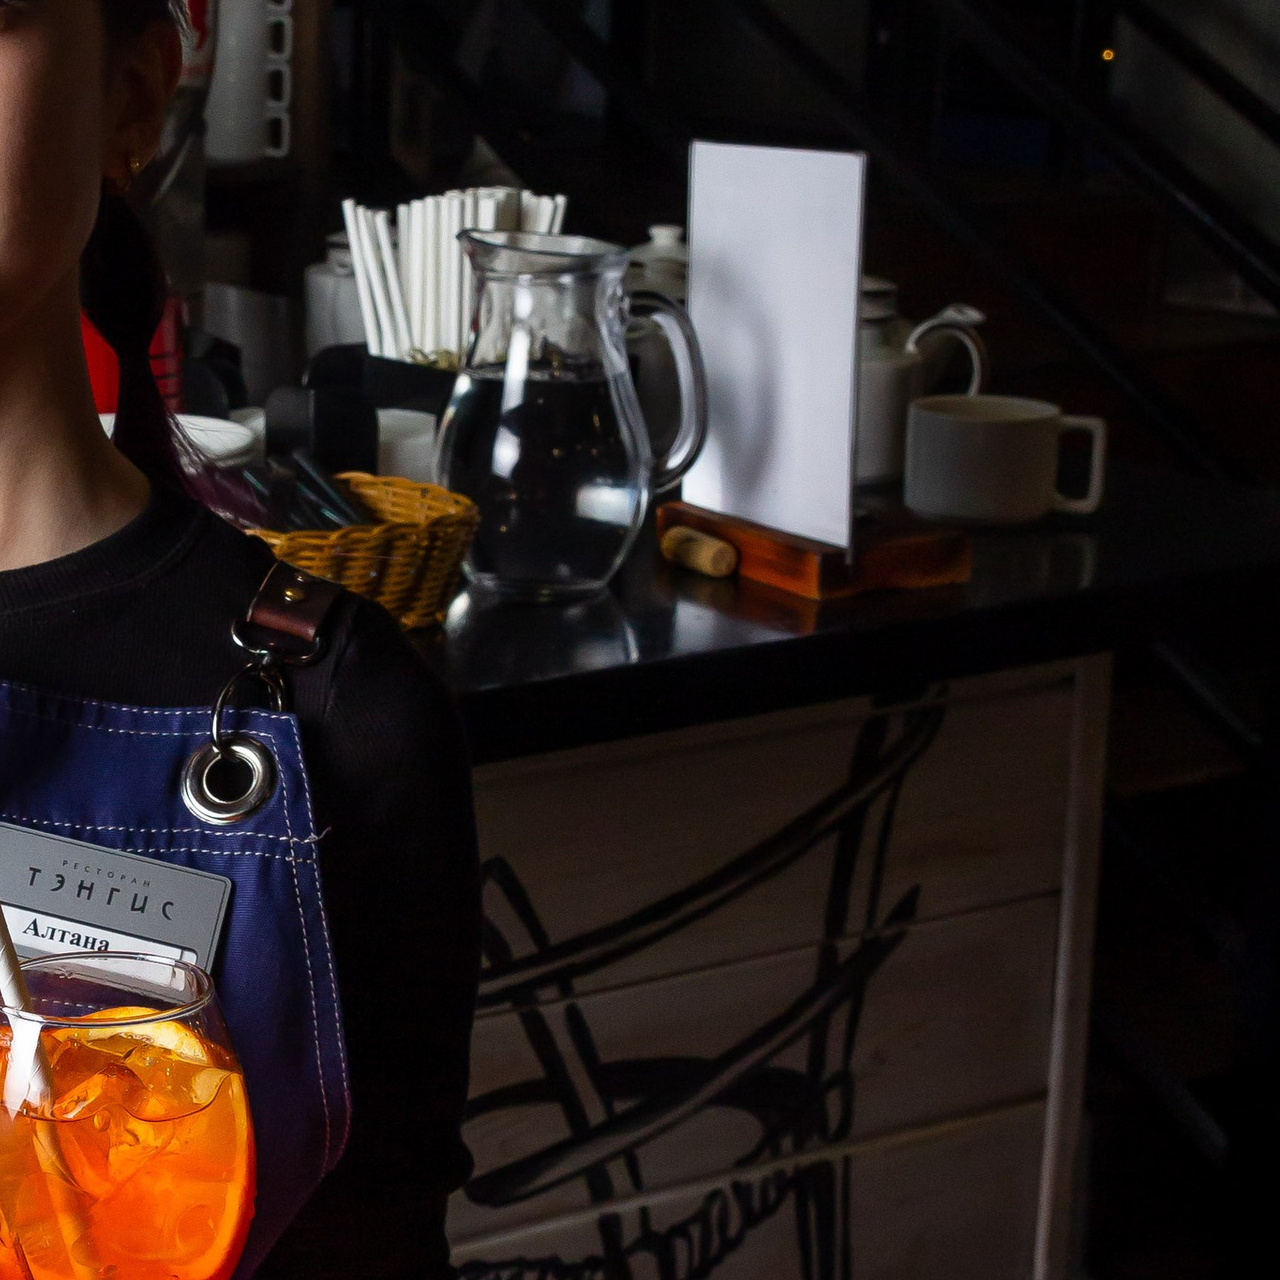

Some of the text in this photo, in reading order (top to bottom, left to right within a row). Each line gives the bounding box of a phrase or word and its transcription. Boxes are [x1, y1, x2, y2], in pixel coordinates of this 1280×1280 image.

[62, 859, 152, 888] РЕСТОРАН
[26, 866, 176, 922] ТЭНГИС
[22, 917, 110, 952] Алтана
